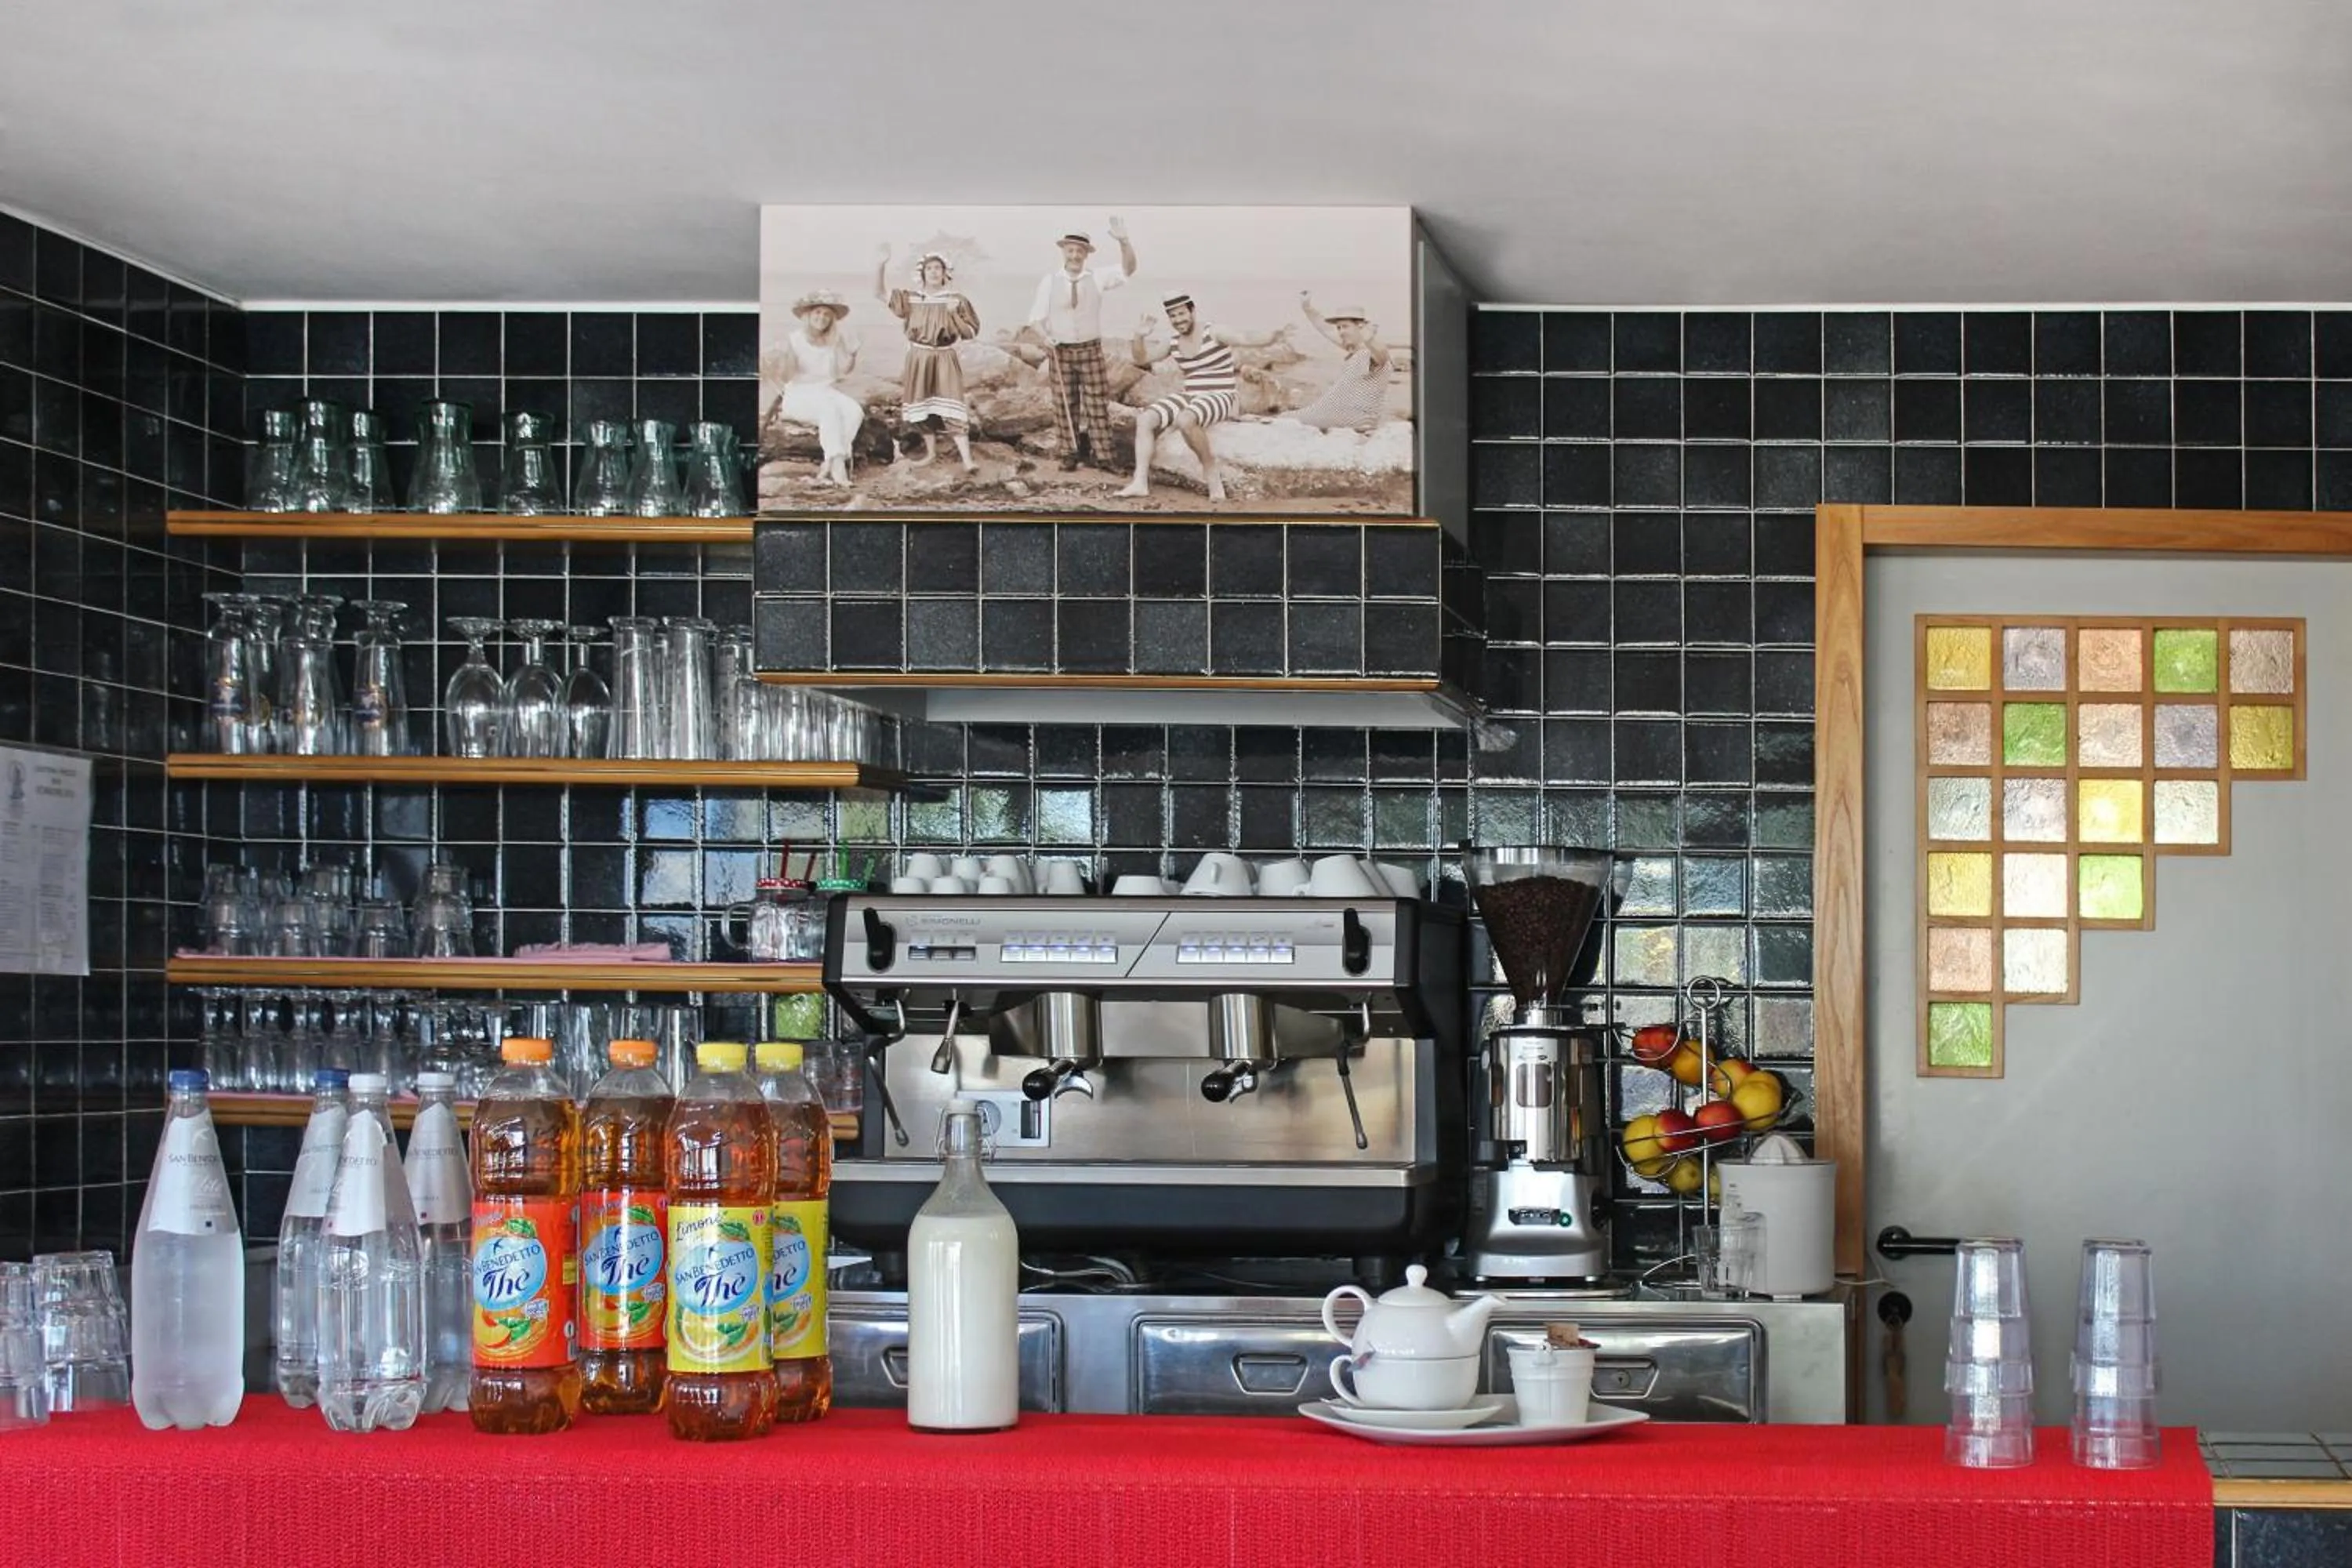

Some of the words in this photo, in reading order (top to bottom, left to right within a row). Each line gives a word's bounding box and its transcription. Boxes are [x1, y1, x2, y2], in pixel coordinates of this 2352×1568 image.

[600, 1231, 659, 1258] BENDETTO
[773, 1240, 806, 1261] DETTO
[481, 1244, 542, 1271] BENEDETTO
[675, 1269, 692, 1286] SAN
